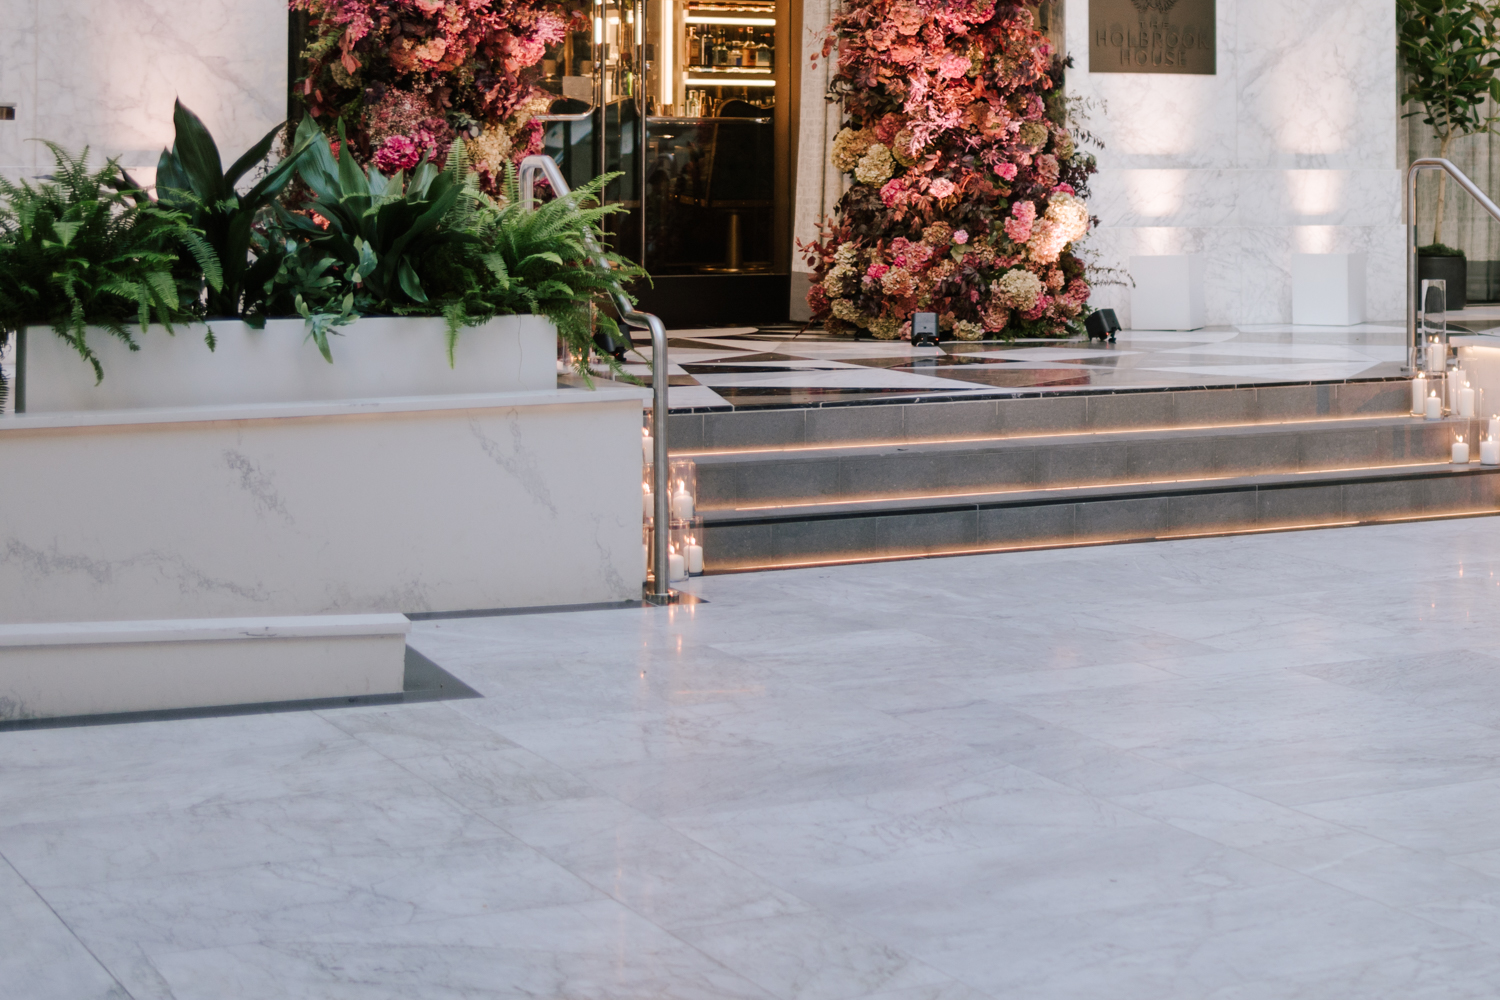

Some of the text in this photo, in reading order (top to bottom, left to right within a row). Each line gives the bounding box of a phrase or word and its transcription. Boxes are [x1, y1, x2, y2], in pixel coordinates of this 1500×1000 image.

[1139, 21, 1169, 29] THE
[1096, 29, 1210, 49] HOLBROOK
[1120, 50, 1187, 67] HOUSE
